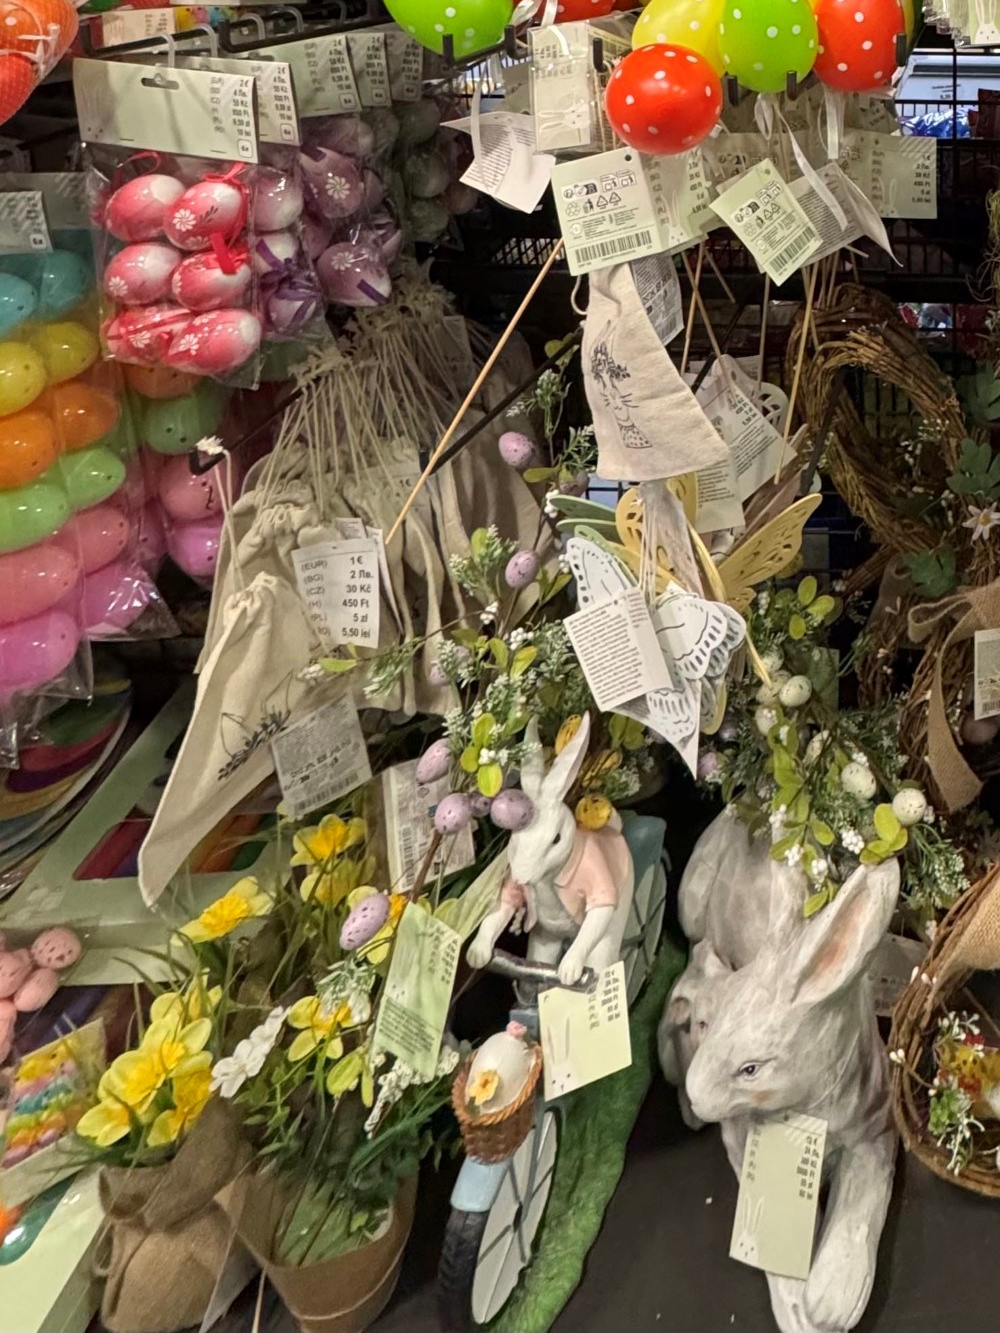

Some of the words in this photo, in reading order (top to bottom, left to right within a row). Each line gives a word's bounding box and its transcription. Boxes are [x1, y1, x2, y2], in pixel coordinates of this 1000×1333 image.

[301, 560, 328, 572] (EUR)
[350, 556, 355, 565] 1
[357, 556, 363, 565] €
[303, 573, 324, 585] (BG)
[350, 570, 356, 579] 2
[358, 570, 374, 579] Лв.
[306, 586, 325, 597] (CZ)
[346, 584, 358, 594] 30
[359, 584, 372, 594] Kč
[308, 600, 322, 609] (H)
[342, 598, 358, 608] 450
[360, 599, 370, 608] Ft
[353, 613, 359, 622] 5
[360, 613, 368, 623] zł
[341, 627, 359, 637] 5,50
[361, 628, 371, 638] lei
